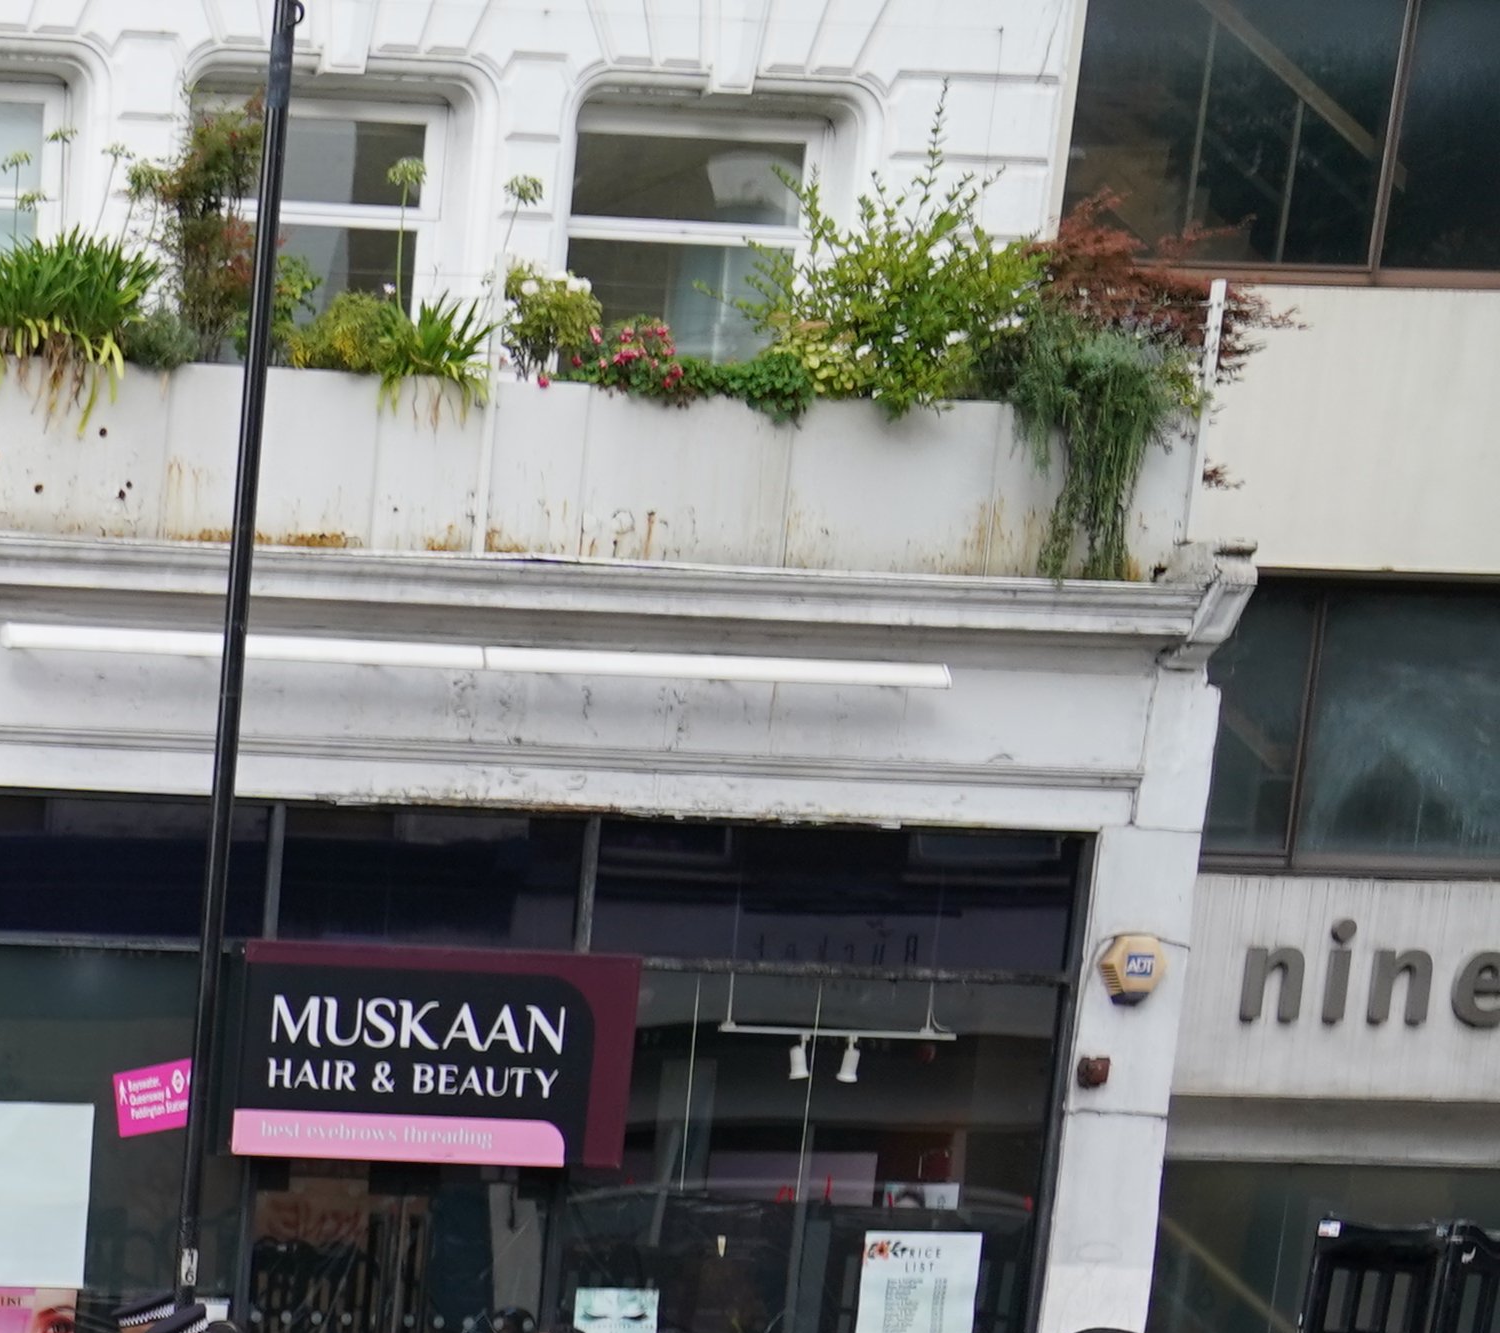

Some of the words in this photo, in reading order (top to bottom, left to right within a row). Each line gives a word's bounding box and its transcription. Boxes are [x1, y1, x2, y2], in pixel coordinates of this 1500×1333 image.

[1127, 957, 1152, 974] ADT
[270, 994, 566, 1055] MUSKAAN
[267, 1057, 356, 1091] HAIR
[371, 1061, 395, 1093] &
[412, 1062, 559, 1099] BEAUTY
